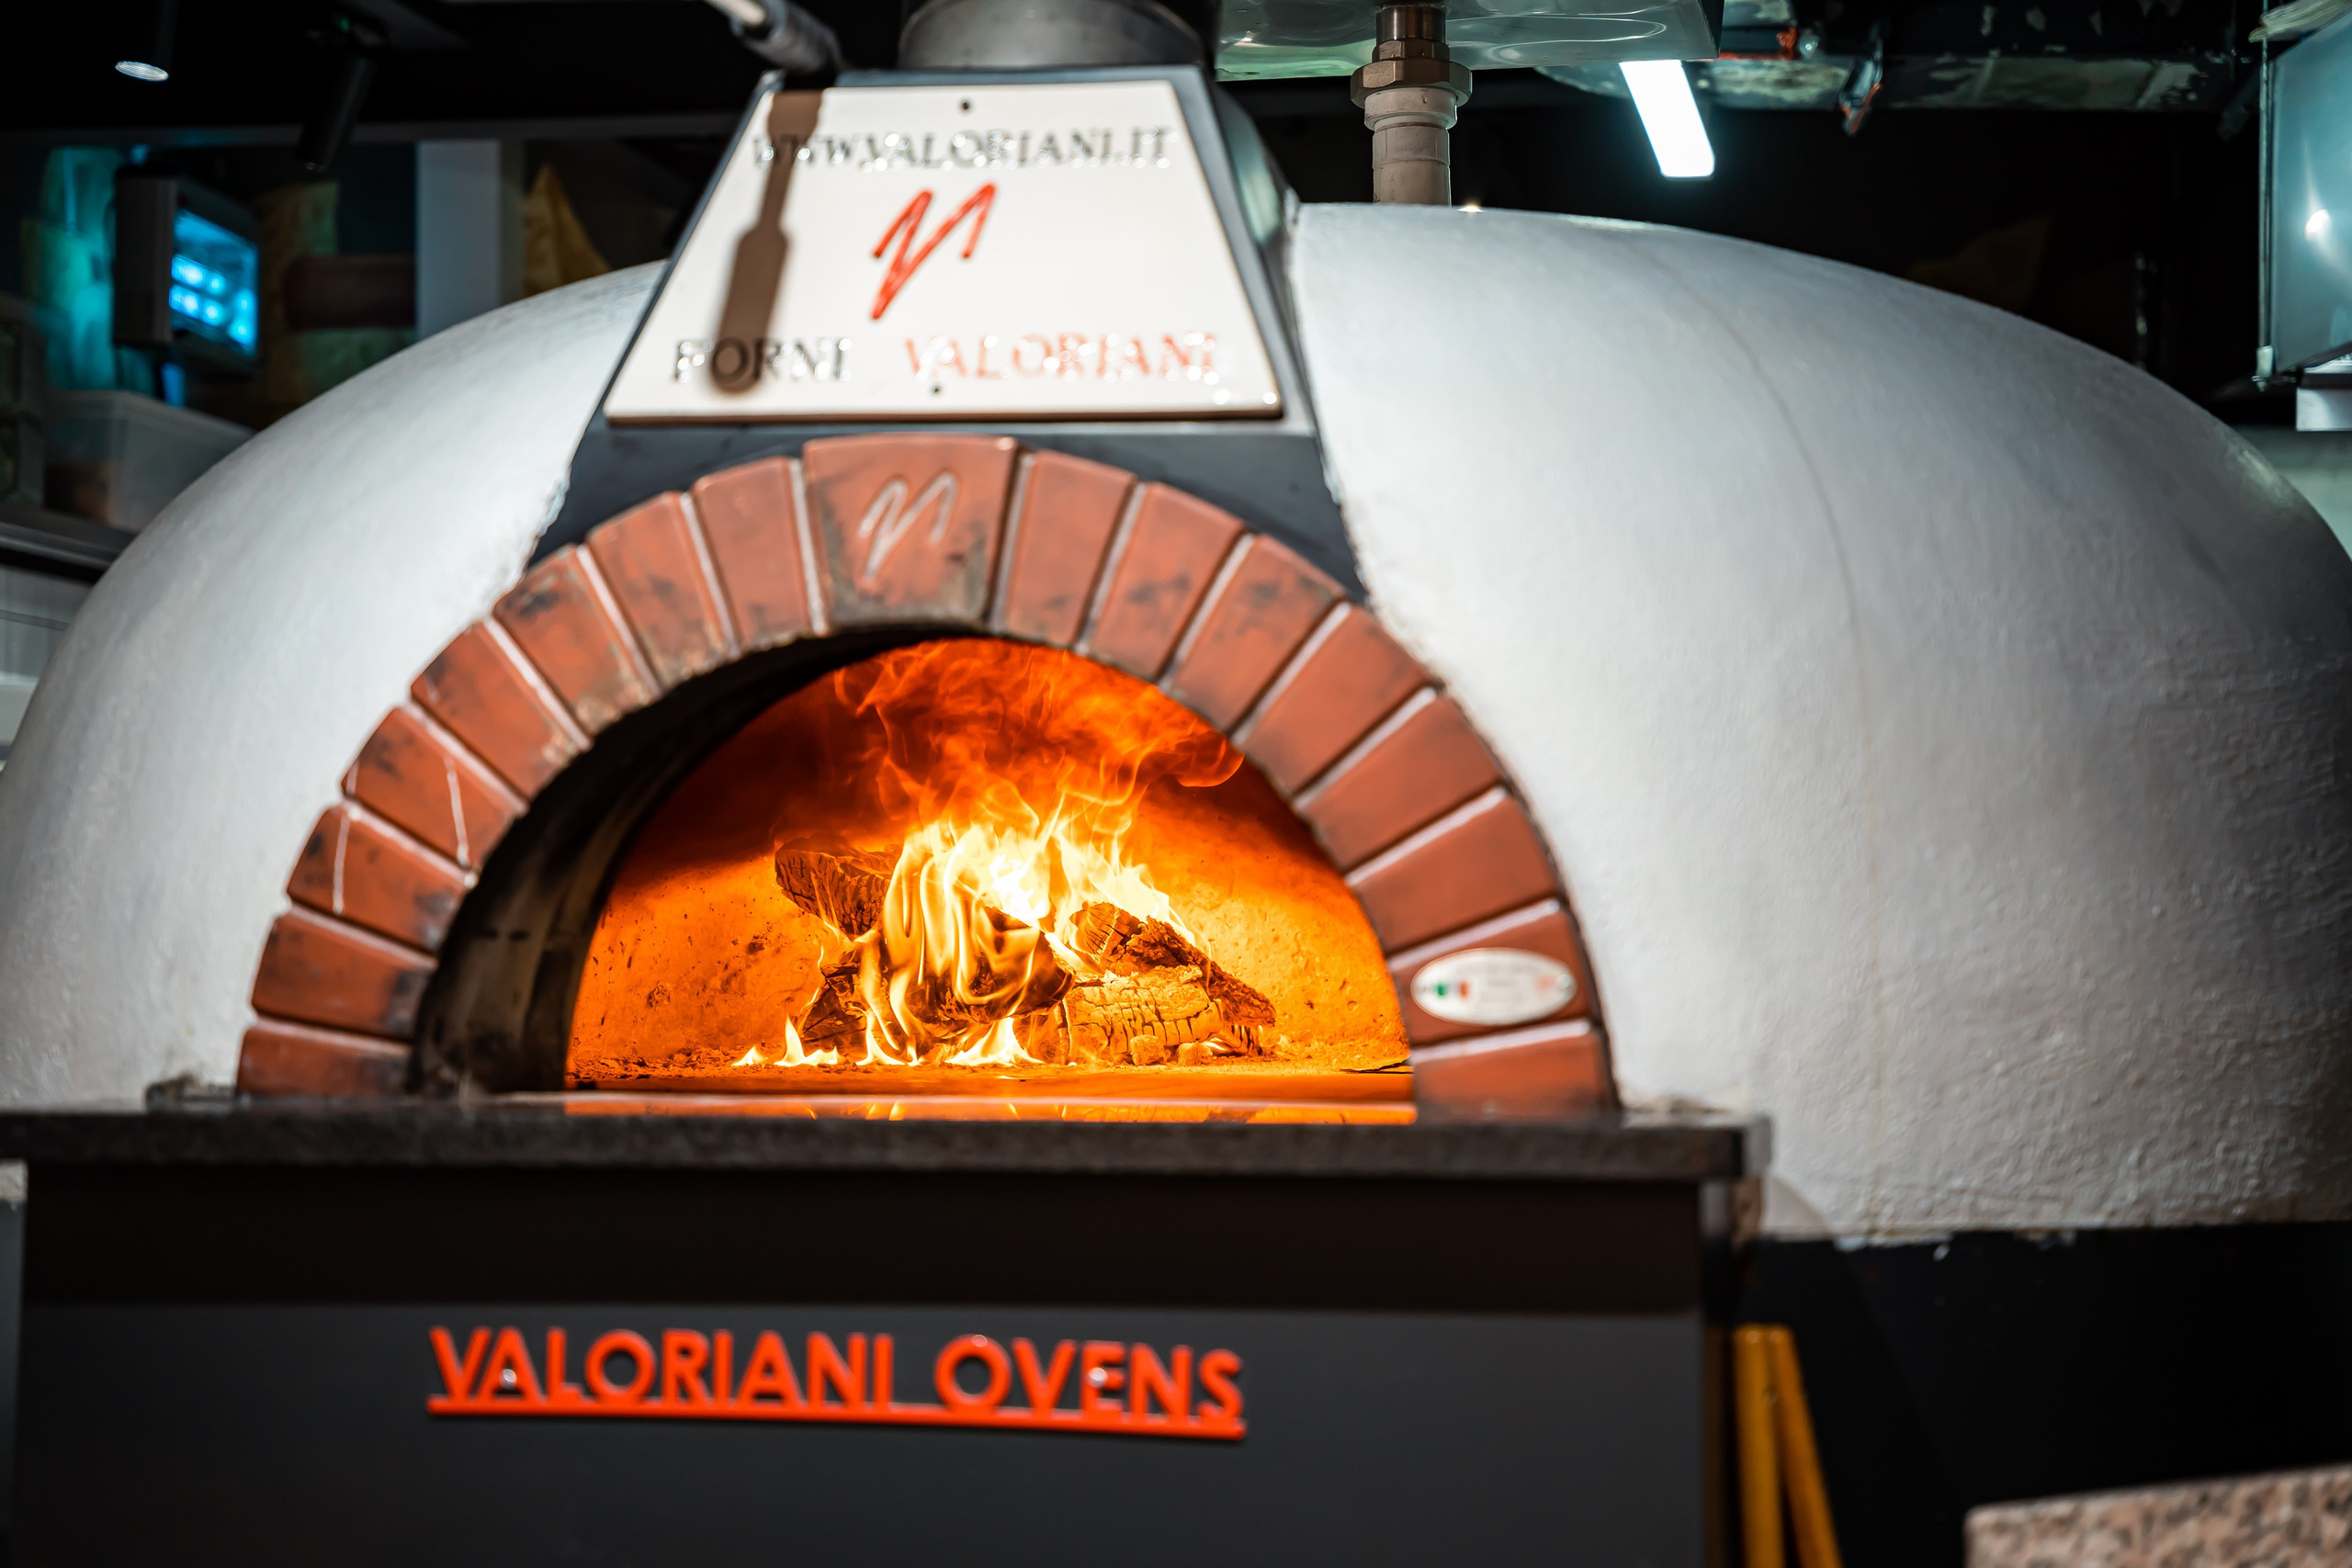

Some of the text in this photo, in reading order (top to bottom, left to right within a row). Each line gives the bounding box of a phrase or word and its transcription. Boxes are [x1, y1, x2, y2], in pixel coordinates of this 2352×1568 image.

[673, 332, 1218, 383] FORNI VALORIANI
[429, 1326, 1244, 1425] VALORIANI OVENS
